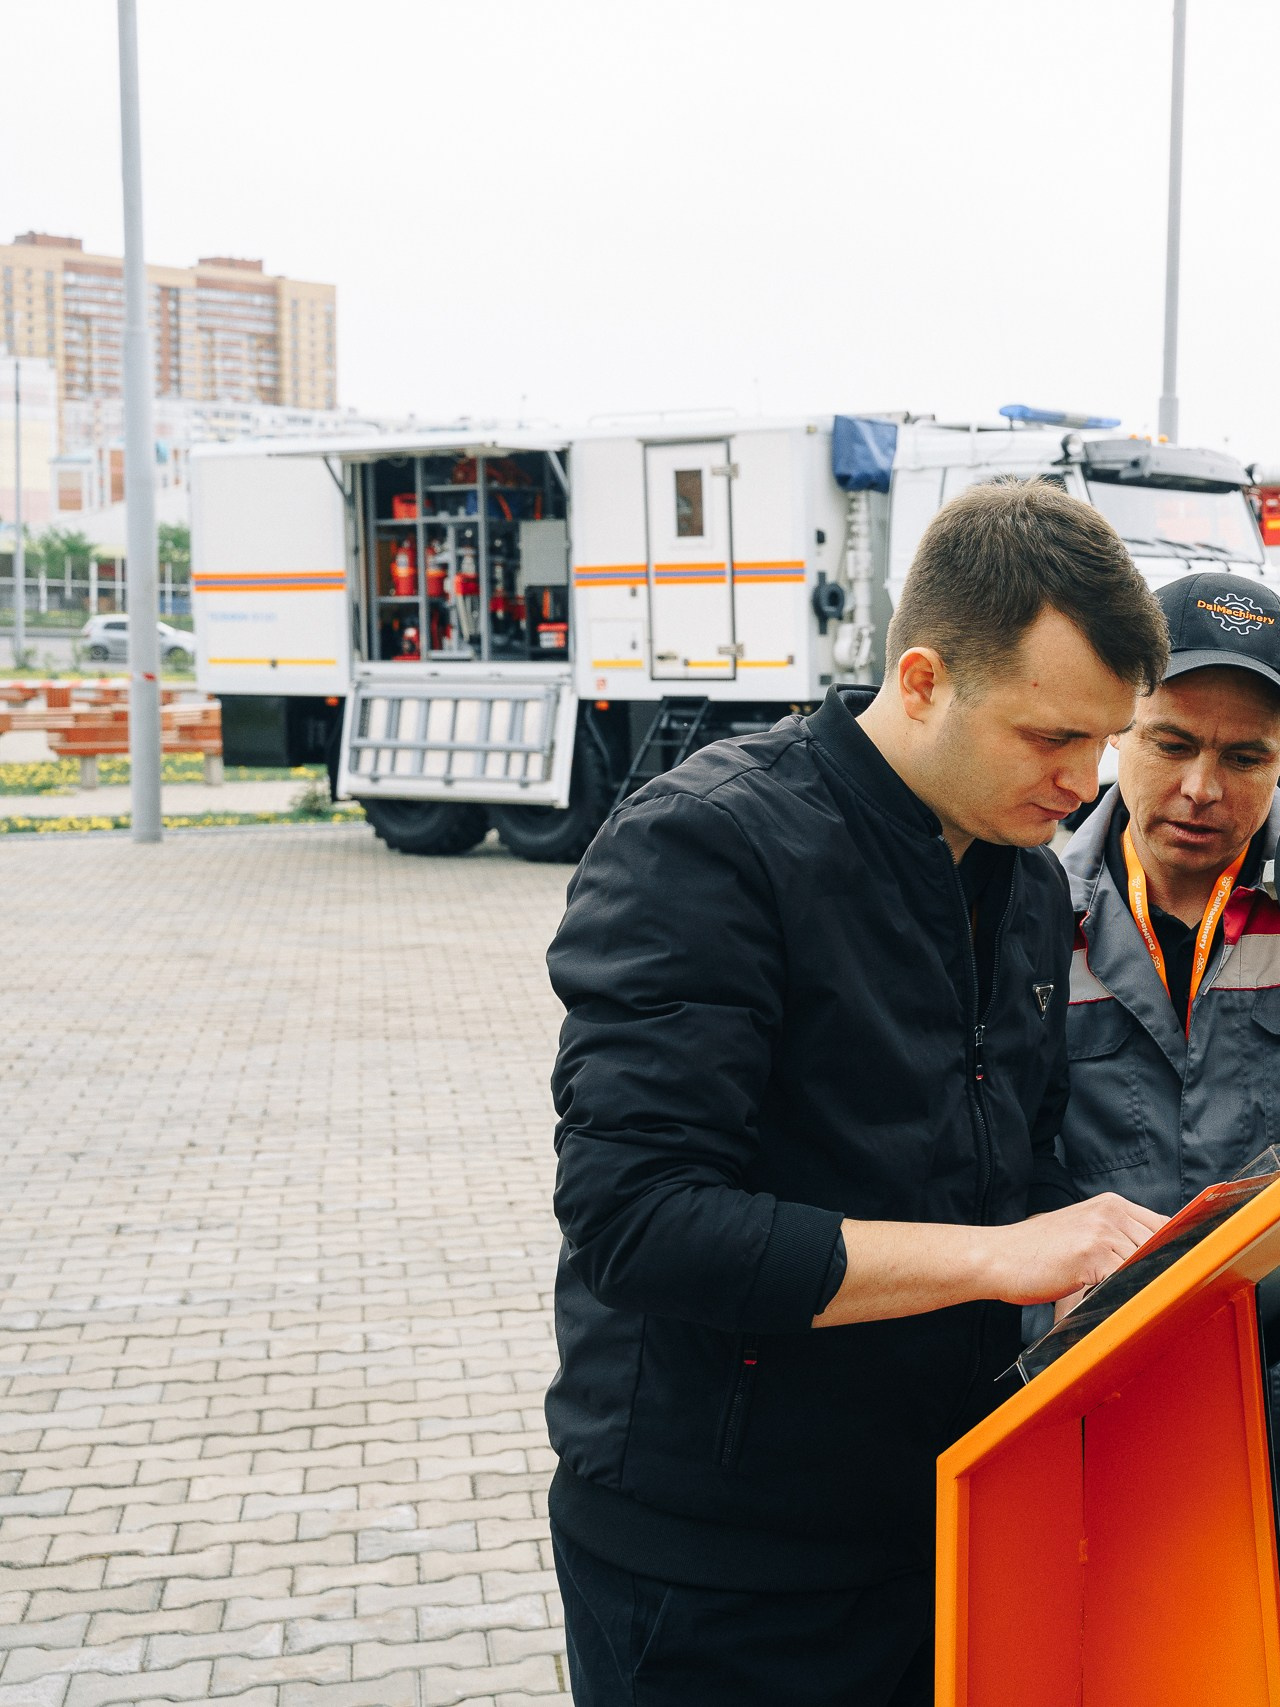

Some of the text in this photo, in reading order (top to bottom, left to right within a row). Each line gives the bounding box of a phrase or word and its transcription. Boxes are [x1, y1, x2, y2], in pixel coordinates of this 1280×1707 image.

[1196, 599, 1275, 625] DalMachinery
[1134, 891, 1156, 951] DalMachinery
[1199, 889, 1226, 949] DalMachinery
